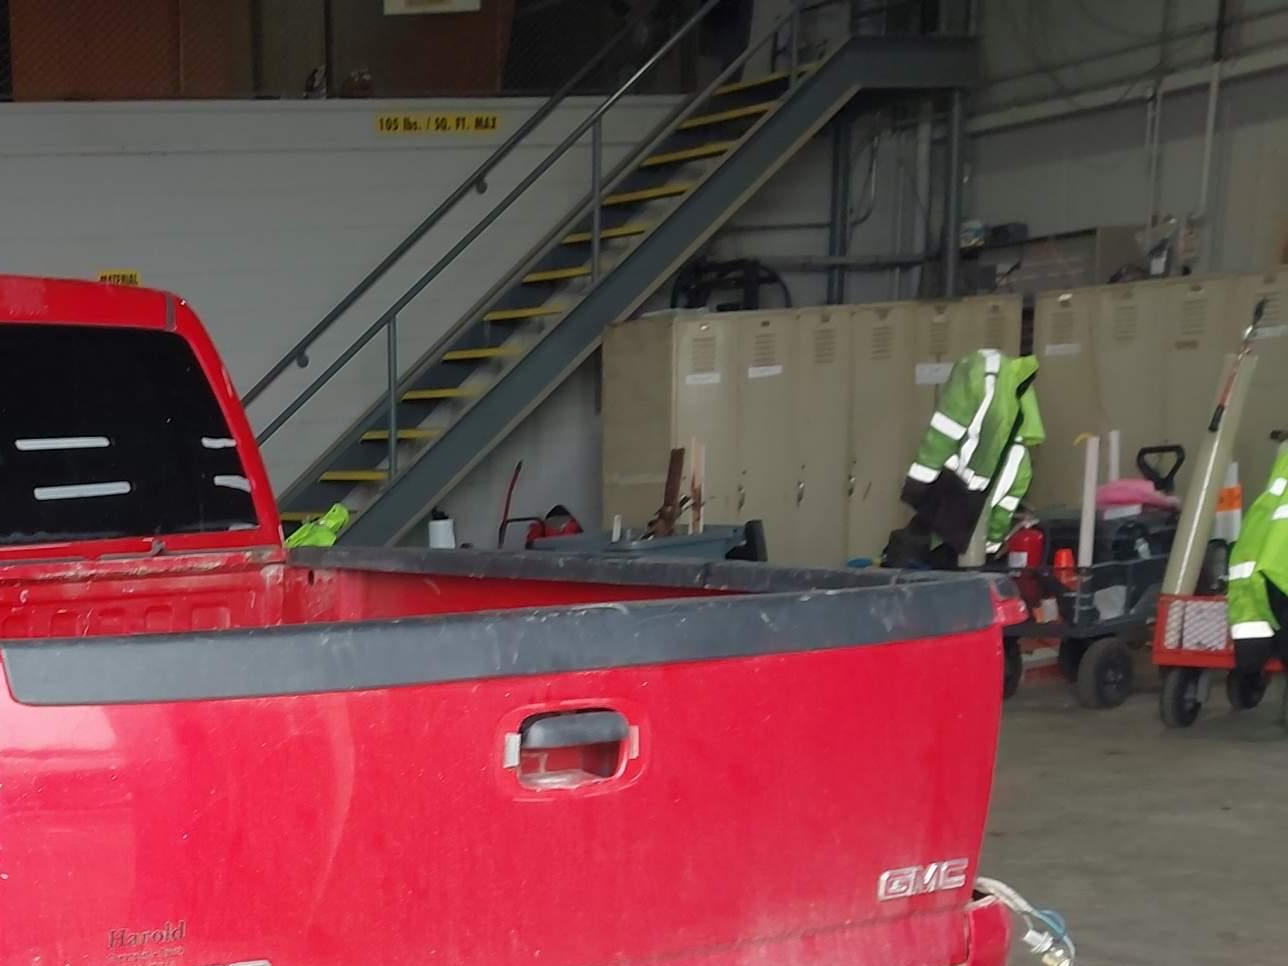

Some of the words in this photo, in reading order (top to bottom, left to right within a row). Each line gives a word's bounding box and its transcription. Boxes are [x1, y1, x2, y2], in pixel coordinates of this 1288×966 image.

[379, 117, 399, 131] 105
[474, 117, 497, 131] MAX
[877, 857, 969, 902] GMC
[108, 919, 186, 948] Harold
